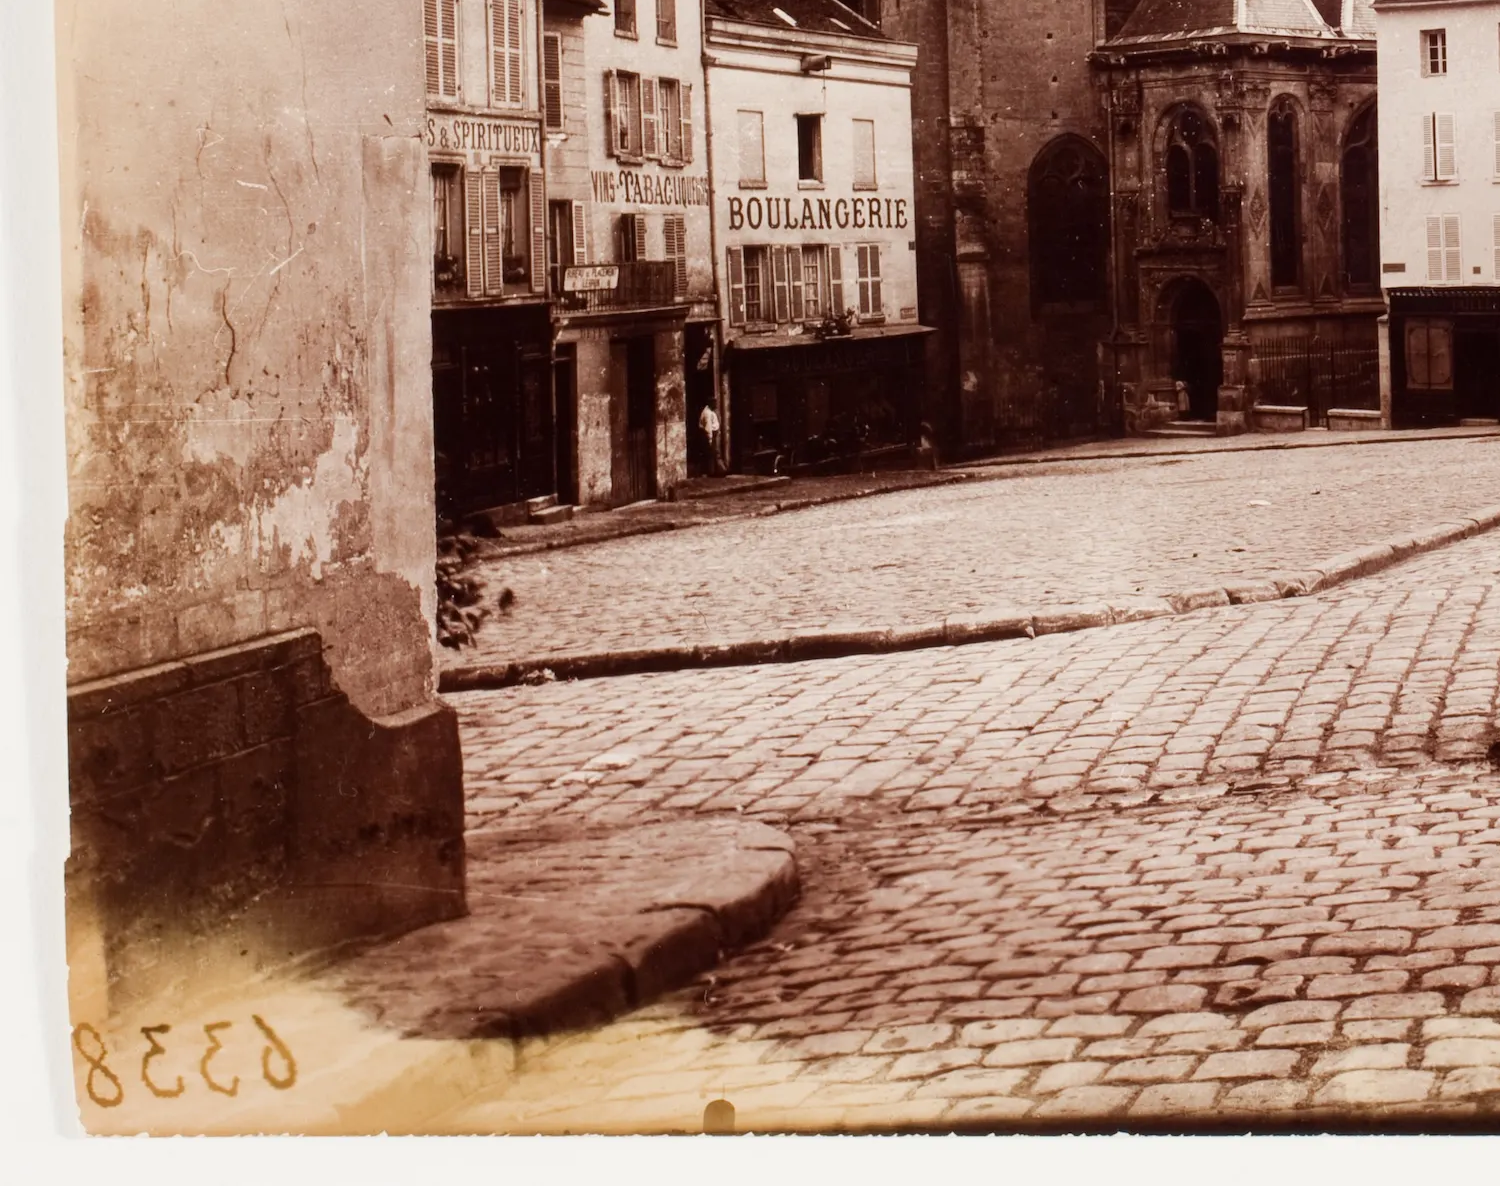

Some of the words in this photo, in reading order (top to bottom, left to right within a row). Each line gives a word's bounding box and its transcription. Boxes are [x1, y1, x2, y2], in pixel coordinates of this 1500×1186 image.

[440, 127, 449, 149] &
[453, 120, 540, 153] SPIRITUEUX
[590, 171, 616, 203] VINS
[619, 170, 671, 206] TABAC
[727, 196, 908, 231] BOULANGERIE
